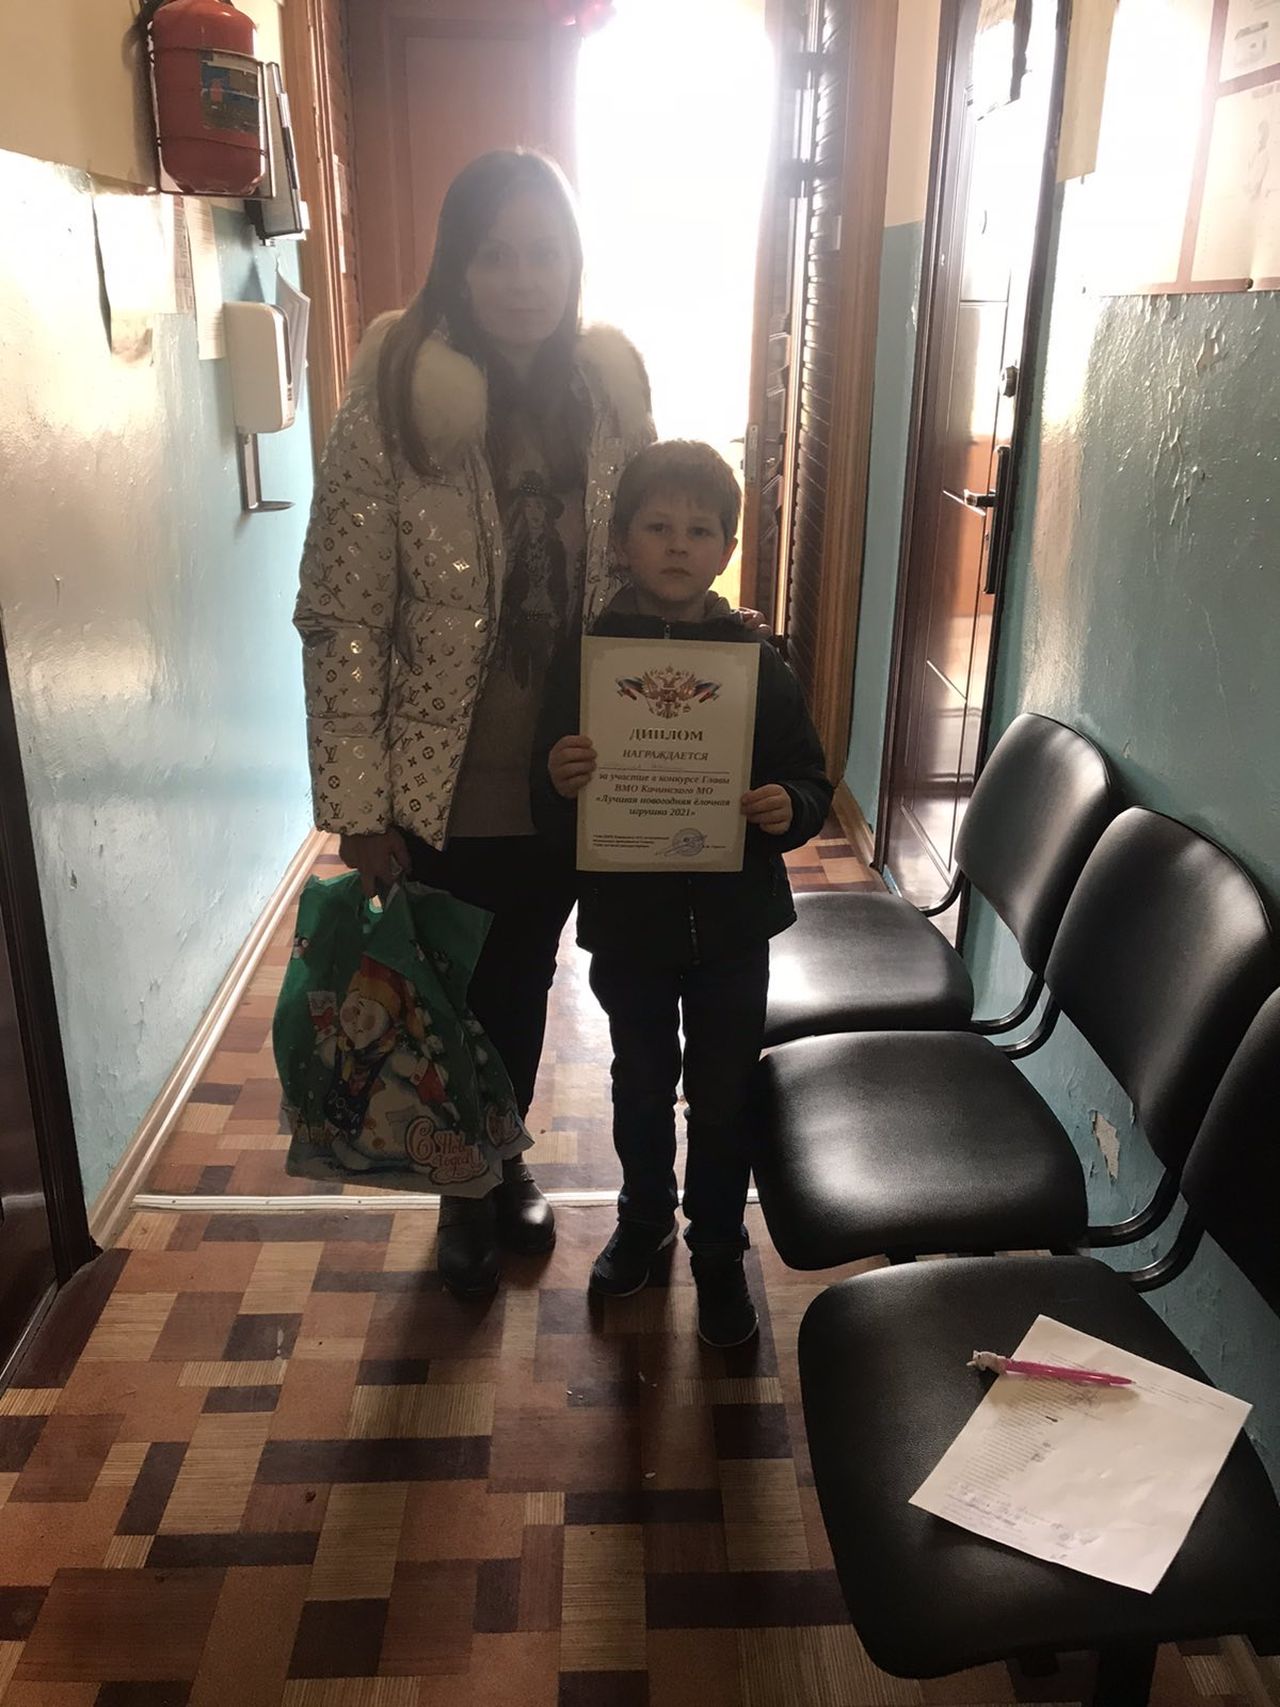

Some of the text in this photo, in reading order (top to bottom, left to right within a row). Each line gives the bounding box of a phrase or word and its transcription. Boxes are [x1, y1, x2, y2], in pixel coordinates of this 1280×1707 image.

[629, 729, 703, 741] ДИПЛОМ
[622, 749, 709, 761] НАГРАЖДАЕТСЯ
[610, 773, 650, 783] участие
[658, 776, 699, 785] конкурсе
[614, 784, 639, 793] ВМО
[696, 787, 714, 795] МО
[640, 797, 691, 806] новогодняя
[629, 808, 668, 818] игрушка
